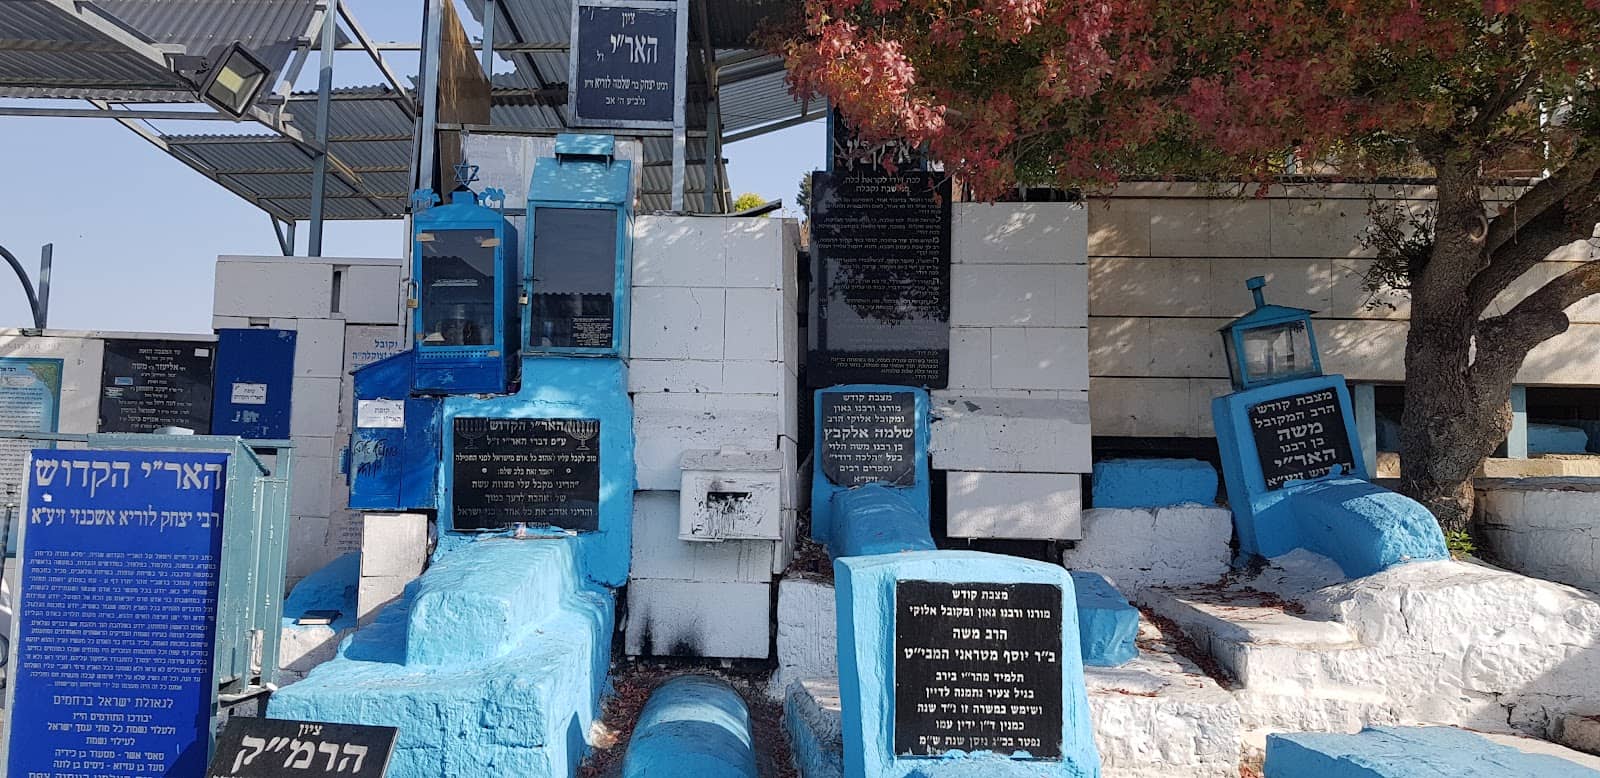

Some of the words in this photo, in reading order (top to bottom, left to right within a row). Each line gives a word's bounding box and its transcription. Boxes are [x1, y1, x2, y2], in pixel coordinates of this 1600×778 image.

[622, 12, 635, 28] ציון
[611, 34, 657, 64] האר"י
[1296, 392, 1332, 405] מצבת
[1256, 401, 1290, 414] קודש
[1310, 405, 1335, 417] הרב
[847, 415, 871, 424] אלוקי
[875, 415, 904, 424] ומקובל
[1254, 411, 1304, 428] המקובל
[824, 426, 869, 440] אלקבץ
[875, 426, 913, 438] שלמה
[1277, 422, 1323, 441] משה
[530, 438, 548, 446] דברי
[829, 441, 846, 450] הלוי
[1280, 442, 1306, 453] רבנו
[1311, 438, 1324, 448] בן
[530, 453, 537, 461] כל
[571, 453, 585, 463] לקבל
[886, 453, 902, 461] בעל
[1274, 449, 1336, 467] האר"י
[142, 460, 222, 490] האר"י
[1308, 463, 1351, 476] הדוש
[36, 458, 130, 498] הקדוש
[517, 479, 530, 488] עלי
[533, 479, 553, 490] מקבל
[485, 494, 503, 503] כמוך
[70, 508, 115, 525] אשכנזי
[120, 505, 156, 526] לוריא
[197, 512, 220, 528] רבי
[160, 511, 192, 532] יצחק
[952, 589, 977, 600] קודש
[982, 590, 1008, 600] מצבת
[910, 604, 936, 617] אלוקי
[941, 605, 973, 618] ומקובל
[978, 608, 996, 618] גאון
[1000, 608, 1023, 618] ורבנו
[1027, 609, 1050, 618] מורנו
[953, 628, 980, 639] משה
[985, 630, 1008, 640] הרב
[904, 648, 949, 660] המבי"ט
[955, 650, 998, 661] מטראני
[1004, 651, 1028, 664] יוסף
[1035, 651, 1056, 662] ב"ר
[936, 671, 957, 681] בירב
[962, 672, 989, 682] מהר"י
[994, 671, 1024, 682] תלמיד
[926, 686, 950, 699] לדיין
[954, 688, 983, 697] נתמנה
[987, 688, 1010, 698] צעיר
[54, 695, 93, 706] ברחמים
[98, 696, 131, 707] ישראל
[134, 697, 173, 709] לגאולת
[918, 703, 936, 712] שנה
[961, 704, 968, 713] זו
[973, 704, 1006, 714] במשרה
[1011, 704, 1042, 714] ושימש
[48, 722, 72, 731] ישראל
[76, 724, 92, 733] עמך
[113, 724, 123, 733] כל
[936, 720, 952, 729] עמו
[957, 720, 975, 731] ידין
[1000, 720, 1024, 732] כמנין
[151, 726, 176, 735] ולעלוי
[298, 724, 323, 737] ציון
[86, 736, 107, 744] נשמת
[111, 736, 135, 745] לעילוי
[945, 736, 964, 745] שנת
[969, 736, 988, 748] ניסן
[1018, 737, 1040, 747] נפטר
[78, 750, 86, 758] בן
[124, 751, 141, 759] אשר
[231, 734, 368, 774] הרמ"ק
[73, 761, 80, 769] בן
[137, 763, 144, 771] בן
